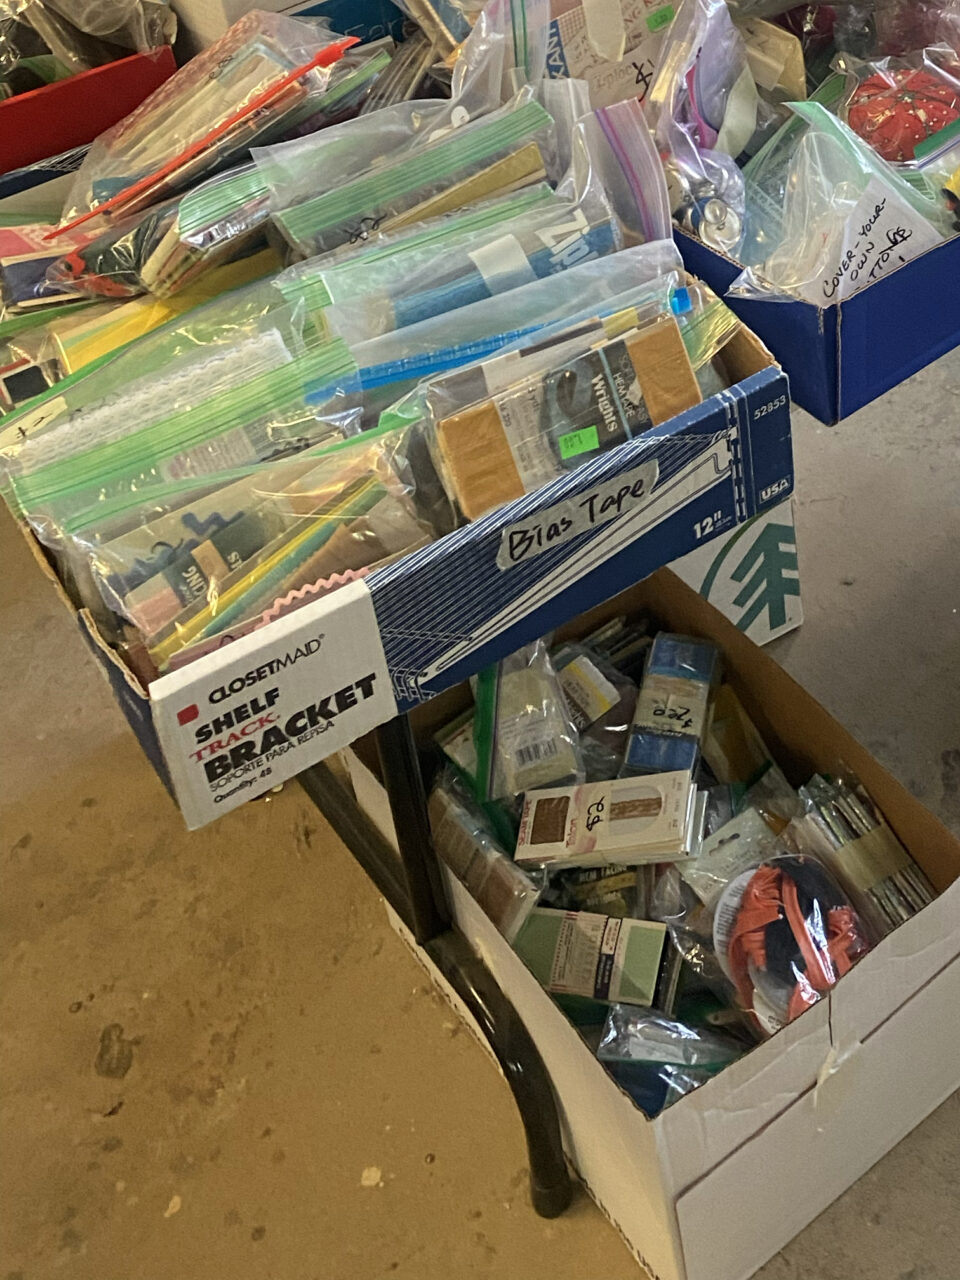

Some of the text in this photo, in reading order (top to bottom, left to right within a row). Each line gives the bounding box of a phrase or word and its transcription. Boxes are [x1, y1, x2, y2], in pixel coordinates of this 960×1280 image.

[591, 374, 619, 433] Wrights
[754, 395, 787, 420] 52853
[760, 477, 792, 500] USA
[508, 478, 645, 562] Bias Tape
[194, 686, 280, 745] SHELF
[203, 672, 377, 783] BRACKET
[210, 719, 335, 792] SOPORTE PARA REPISA
